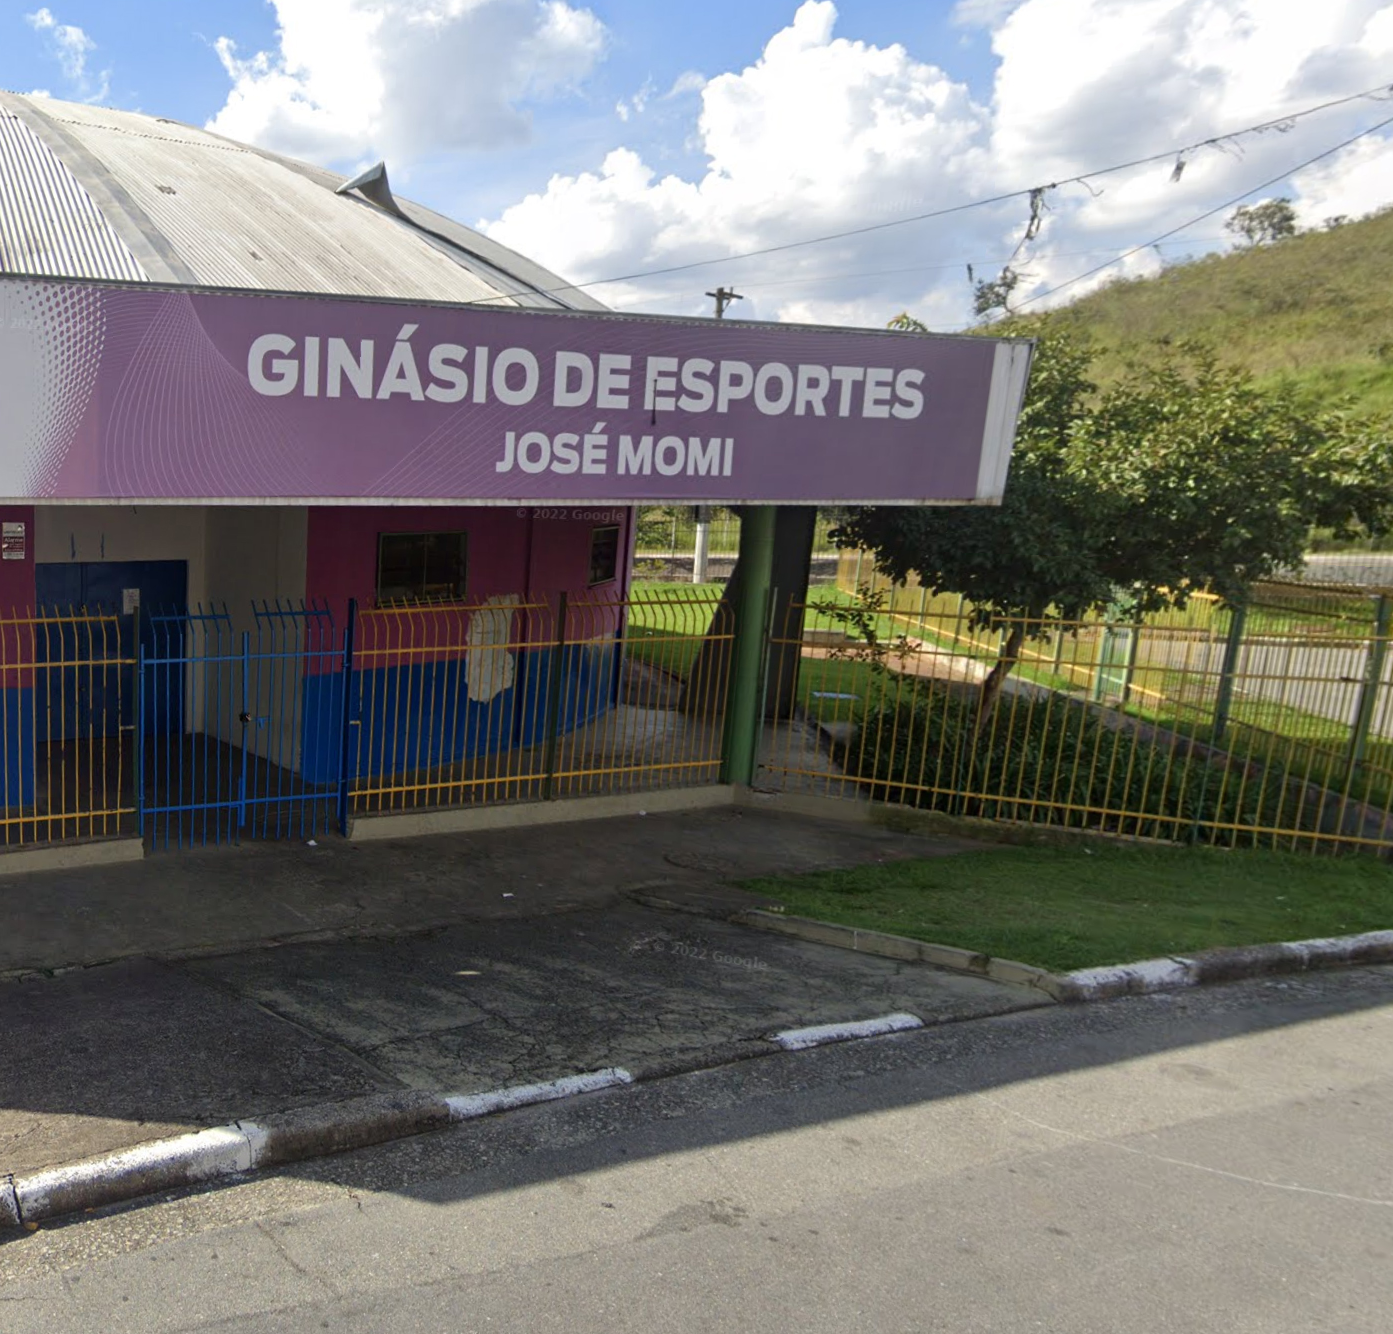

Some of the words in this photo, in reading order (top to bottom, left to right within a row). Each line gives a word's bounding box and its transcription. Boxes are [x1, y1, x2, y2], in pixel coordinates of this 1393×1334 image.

[247, 323, 540, 406] GINÁSIO
[553, 350, 632, 409] DE
[643, 355, 925, 420] ESPORTES
[495, 421, 608, 475] JOSÉ
[617, 434, 735, 477] MOMI
